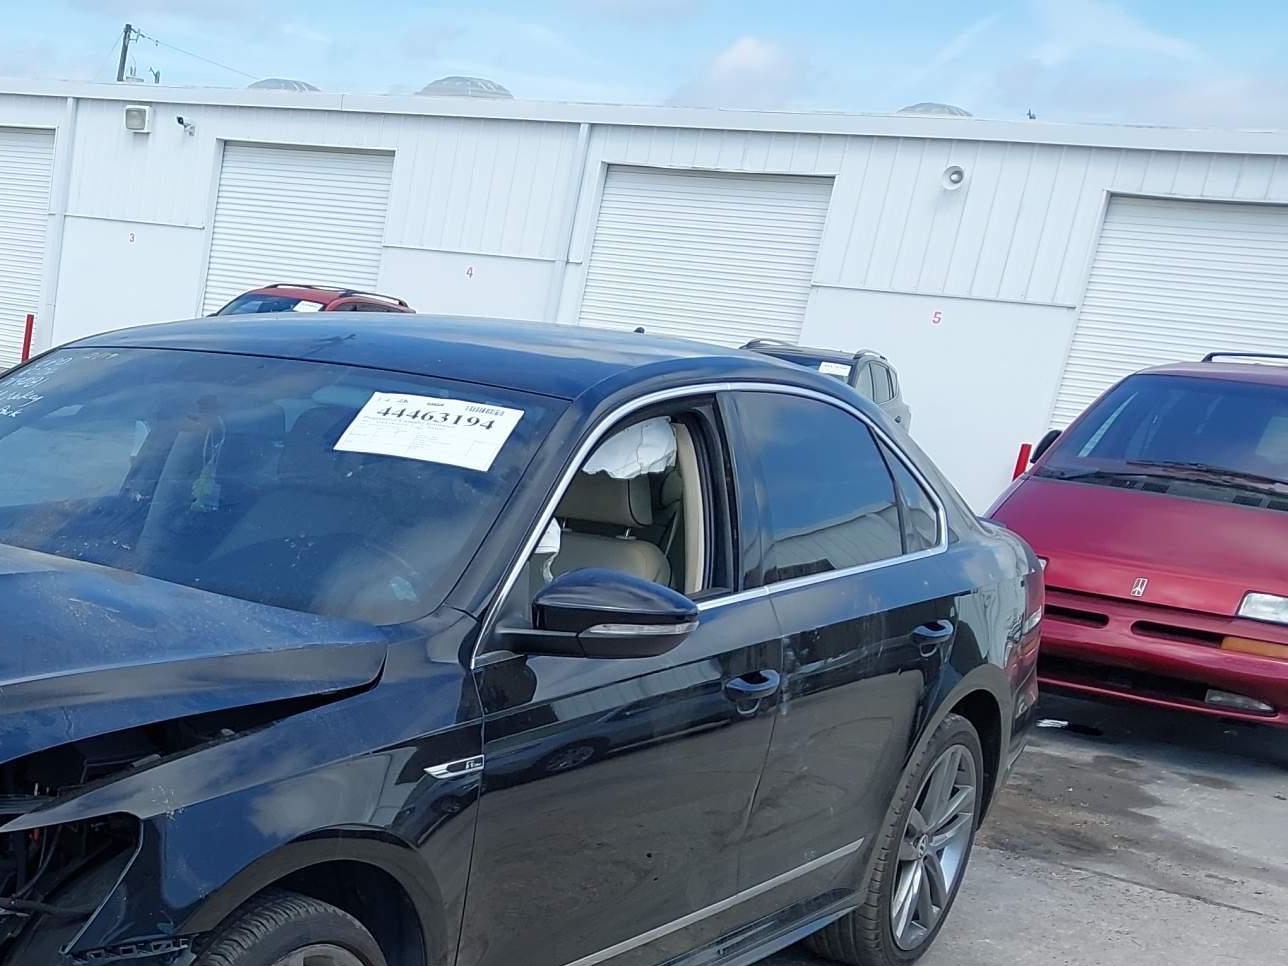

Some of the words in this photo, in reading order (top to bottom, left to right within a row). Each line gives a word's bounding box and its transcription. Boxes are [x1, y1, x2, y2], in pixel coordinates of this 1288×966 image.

[466, 266, 473, 279] 4
[932, 311, 942, 324] 5
[376, 406, 495, 431] 44463194
